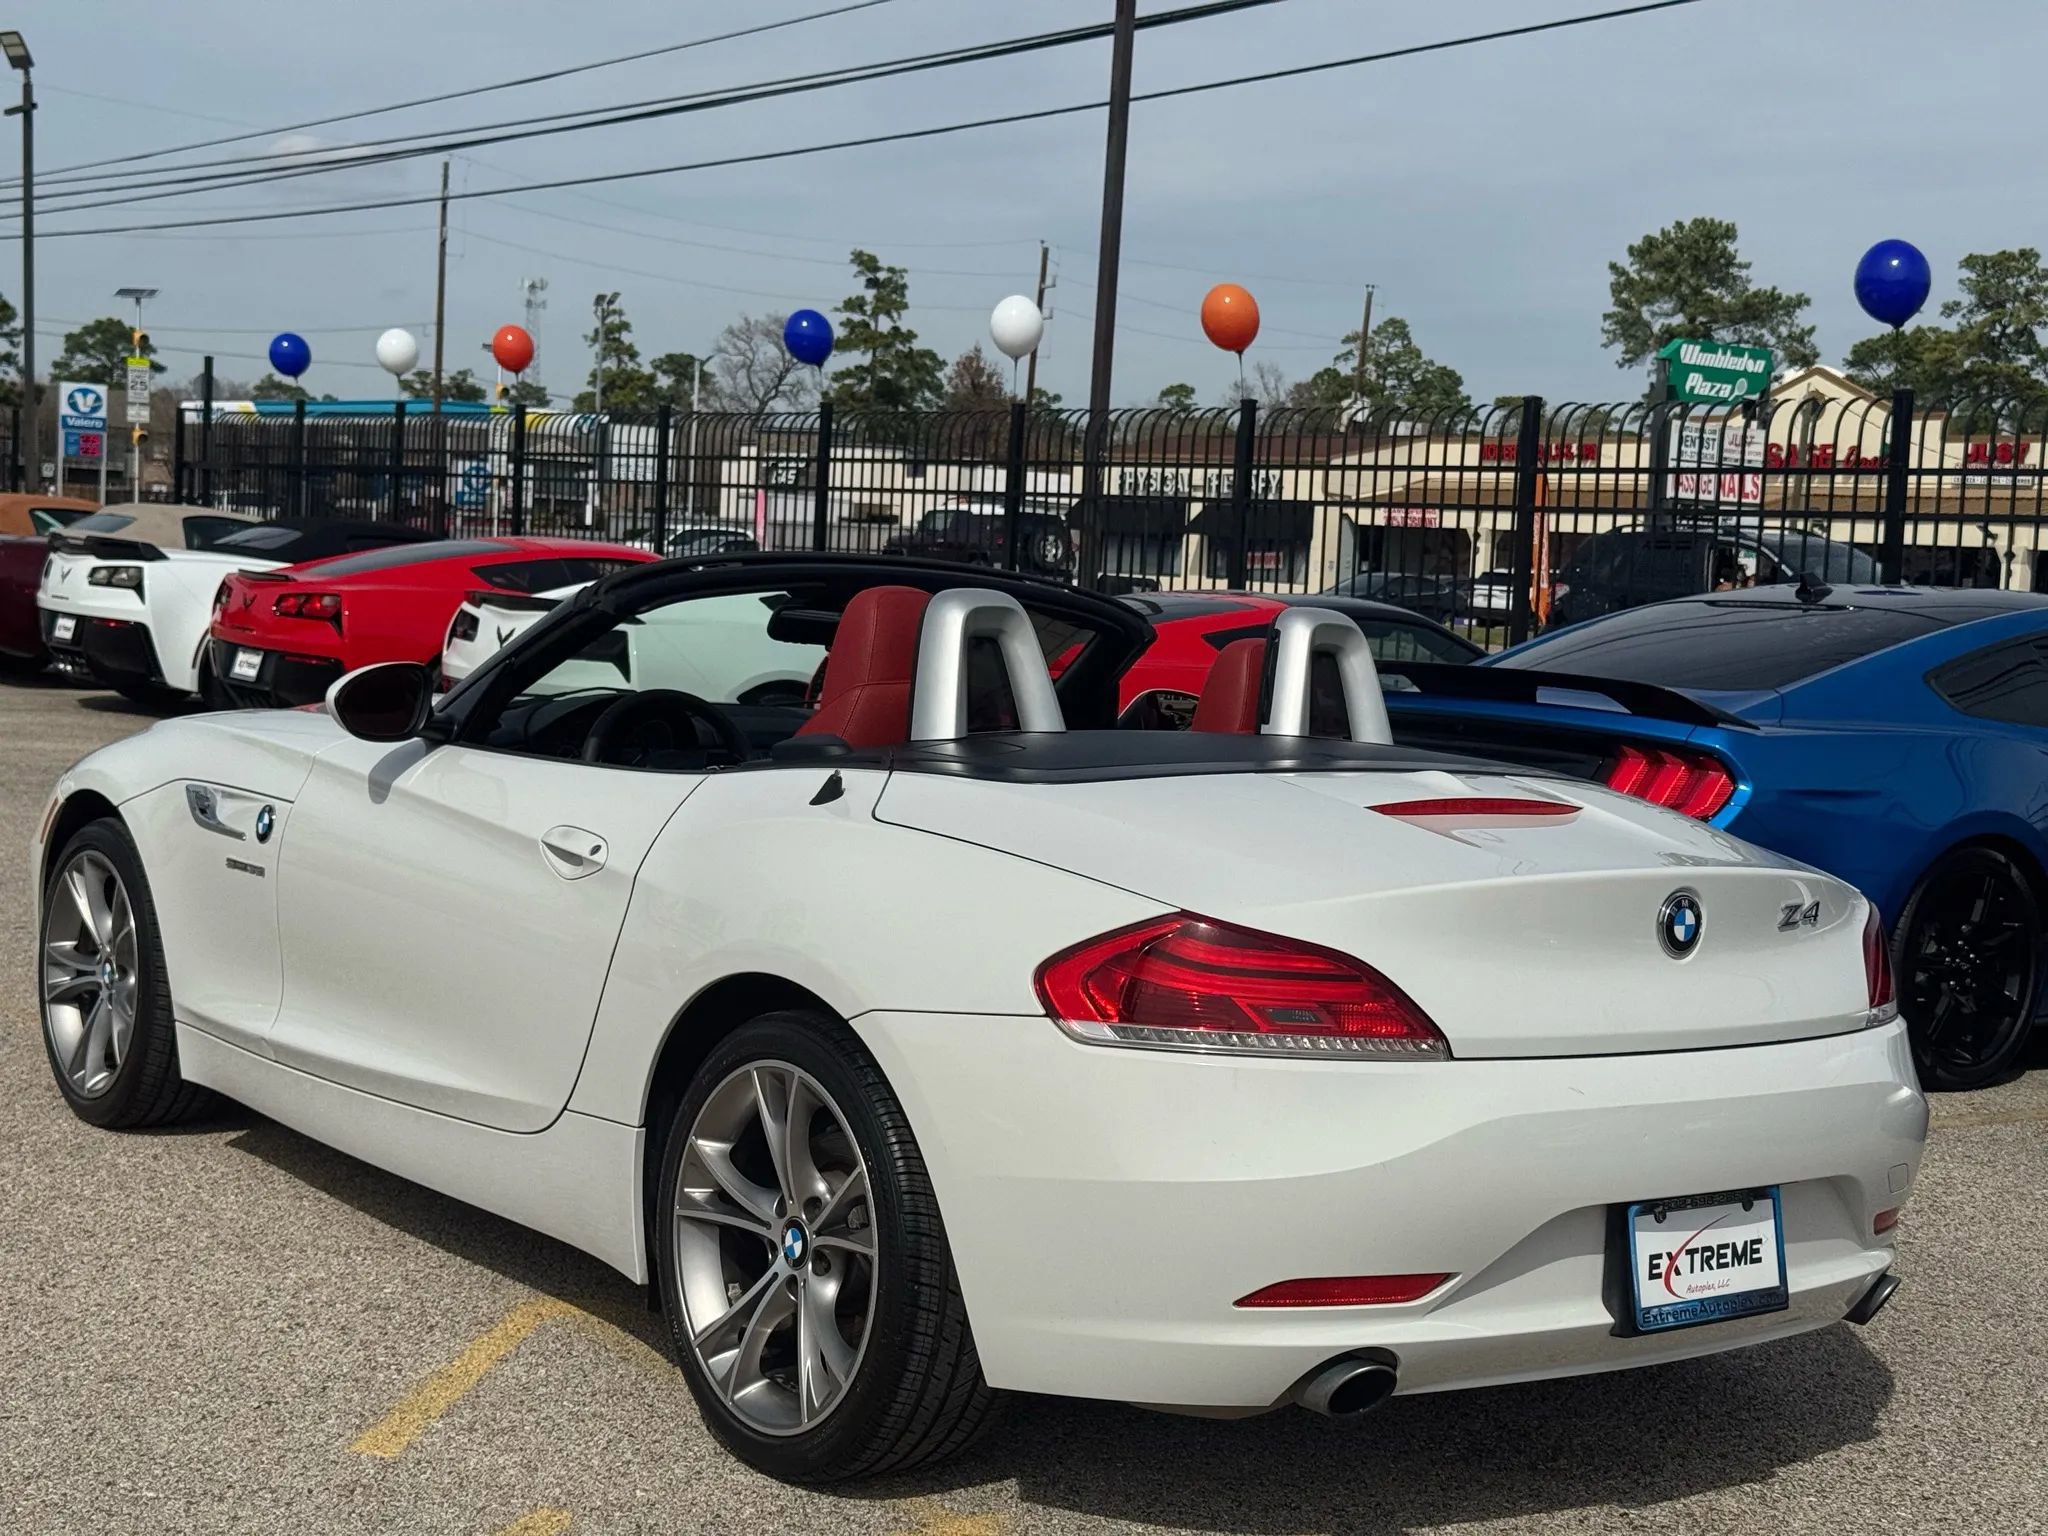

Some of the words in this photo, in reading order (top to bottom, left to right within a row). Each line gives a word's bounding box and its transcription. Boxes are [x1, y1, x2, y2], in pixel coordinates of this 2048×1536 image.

[1680, 343, 1766, 373] Wimbledon
[130, 381, 148, 391] 25
[1685, 372, 1733, 398] Plaza
[66, 417, 104, 428] Valero
[1719, 474, 1760, 500] NALS
[1777, 900, 1820, 932] Z4
[1648, 1238, 1763, 1281] EXTREME
[1717, 1278, 1731, 1288] LLC
